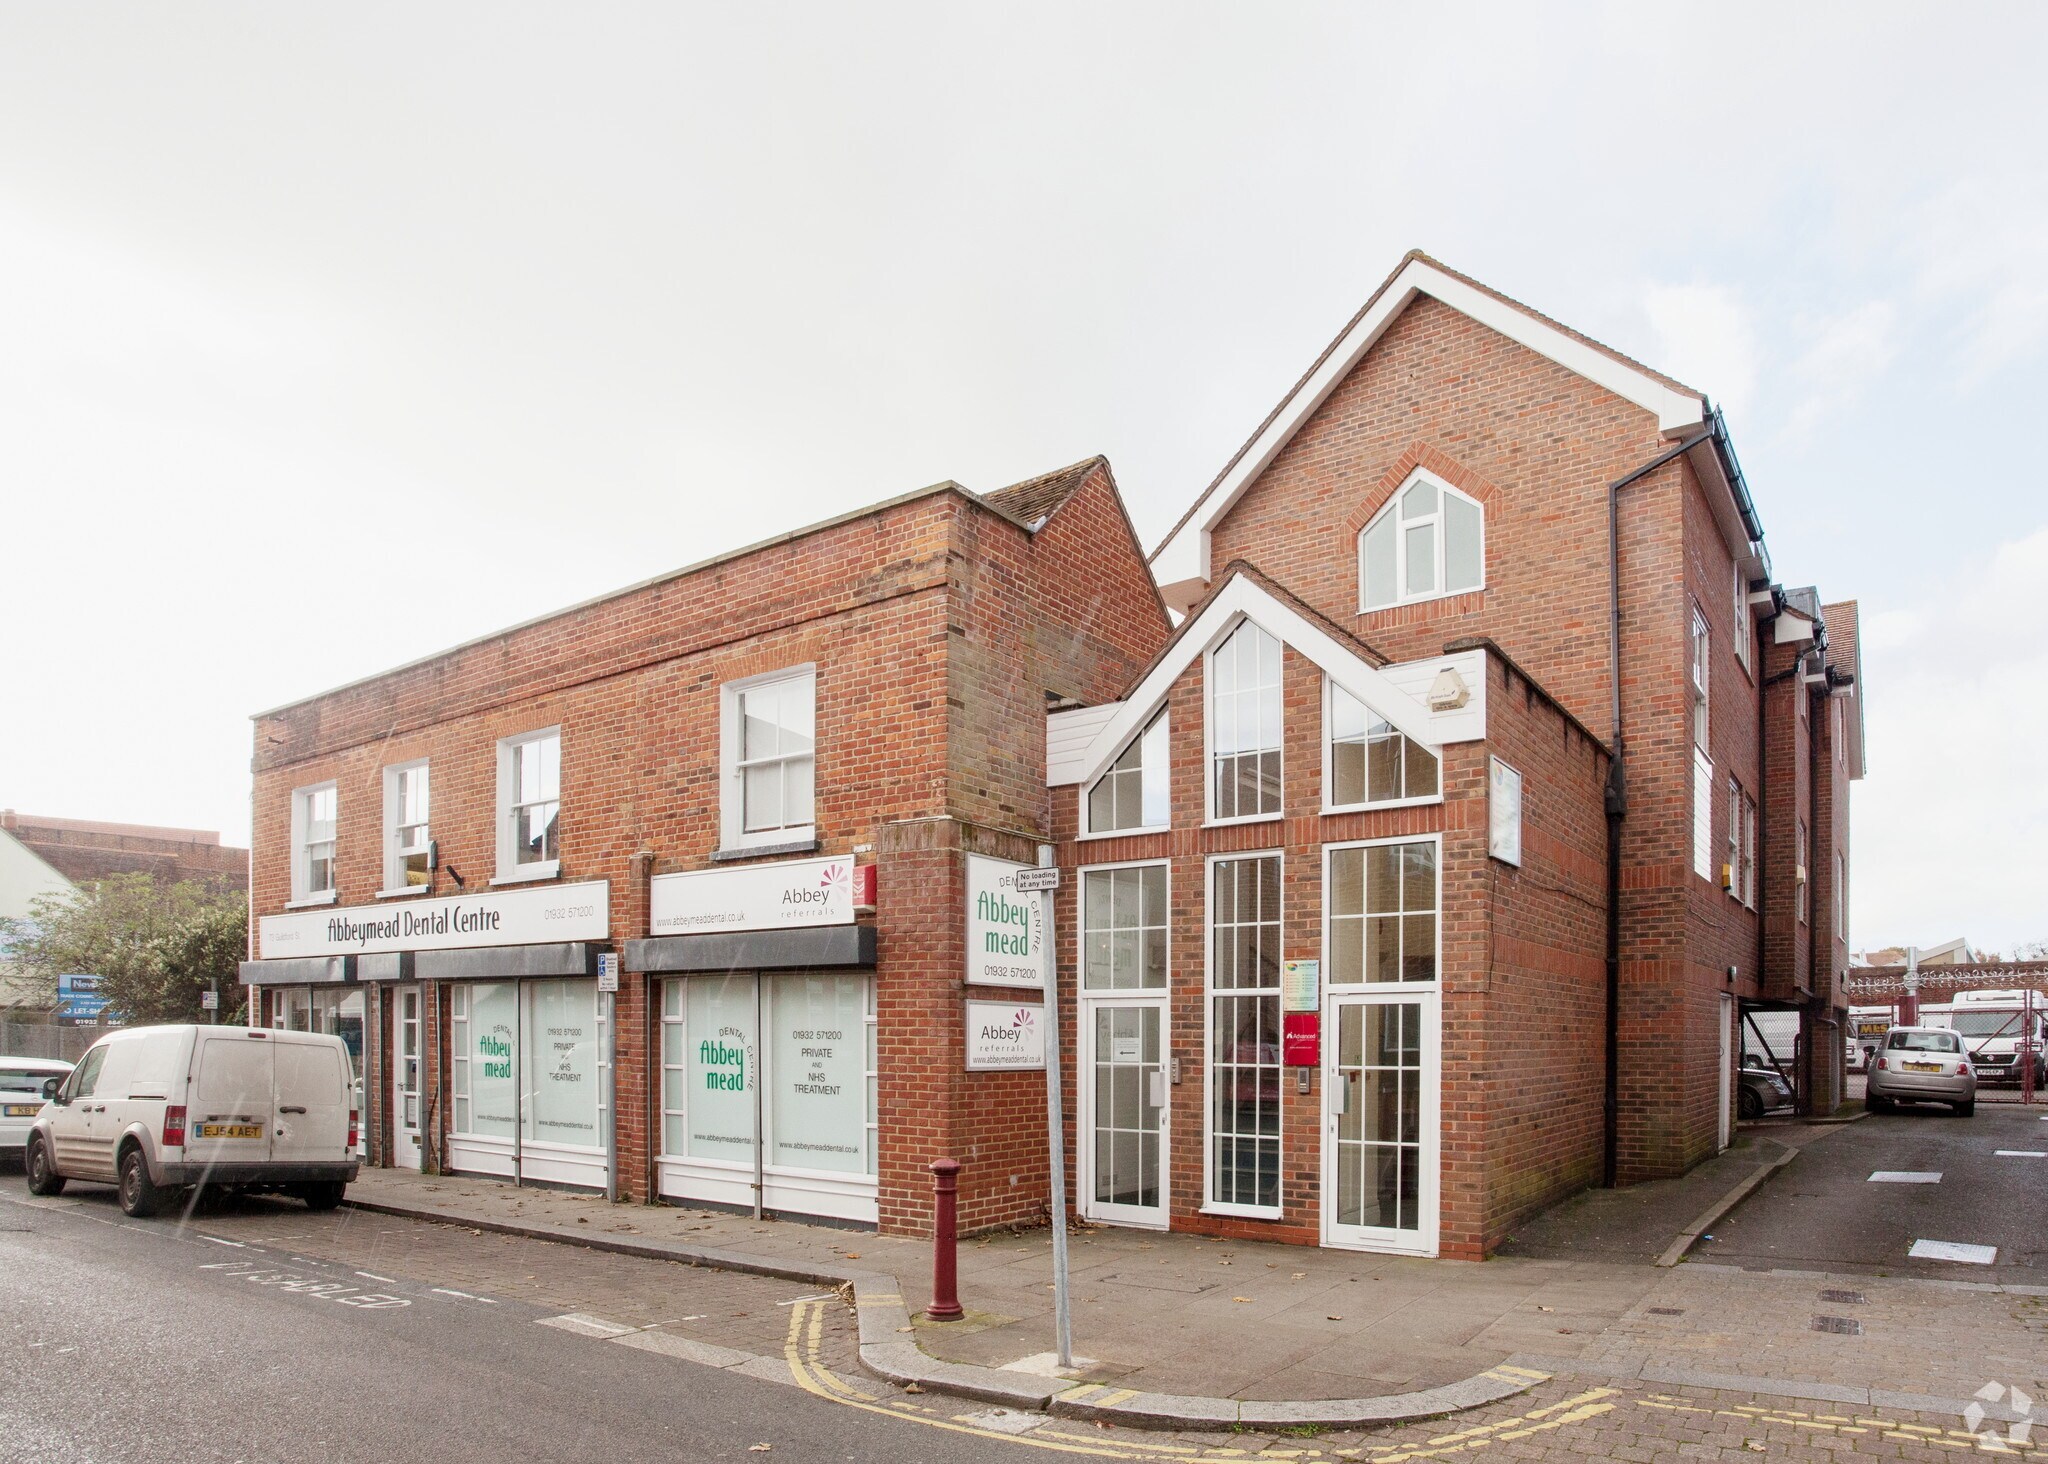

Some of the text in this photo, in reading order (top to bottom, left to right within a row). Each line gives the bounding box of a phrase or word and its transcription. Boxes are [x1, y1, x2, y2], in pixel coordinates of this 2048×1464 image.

[1031, 871, 1056, 881] loading
[781, 887, 830, 906] Abbey
[544, 905, 594, 920] 01932 571200
[780, 907, 835, 918] referrals
[977, 890, 1029, 928] Abbey
[328, 905, 500, 947] Abbeymead Dental Centre
[656, 911, 745, 929] www.abbeymeaddental.co.uk
[1030, 900, 1042, 954] CENTRE
[985, 929, 1029, 956] mead
[984, 965, 1036, 979] 01932 571200
[493, 1024, 513, 1039] DENTAL
[547, 1028, 582, 1037] 01932 571200
[719, 1026, 747, 1044] DENTAL
[792, 1030, 842, 1040] 01932 571200
[981, 1026, 1021, 1043] Abbey
[480, 1035, 511, 1058] Abbey
[553, 1042, 576, 1051] PRIVATE
[700, 1039, 744, 1068] Abbey
[801, 1048, 833, 1058] PRIVATE
[979, 1045, 1025, 1053] referrals
[558, 1063, 571, 1072] NHS
[973, 1055, 1041, 1067] www.abbeymeaddental.co.uk
[484, 1059, 511, 1079] mead
[549, 1073, 582, 1082] TREATMENT
[706, 1070, 744, 1091] mead
[808, 1073, 826, 1082] NHS
[794, 1084, 841, 1095] TREATMENT
[203, 1126, 234, 1136] EJ54
[779, 1141, 859, 1154] www.abbeymeaddental.co.uk
[199, 1260, 412, 1310] DISABLED
